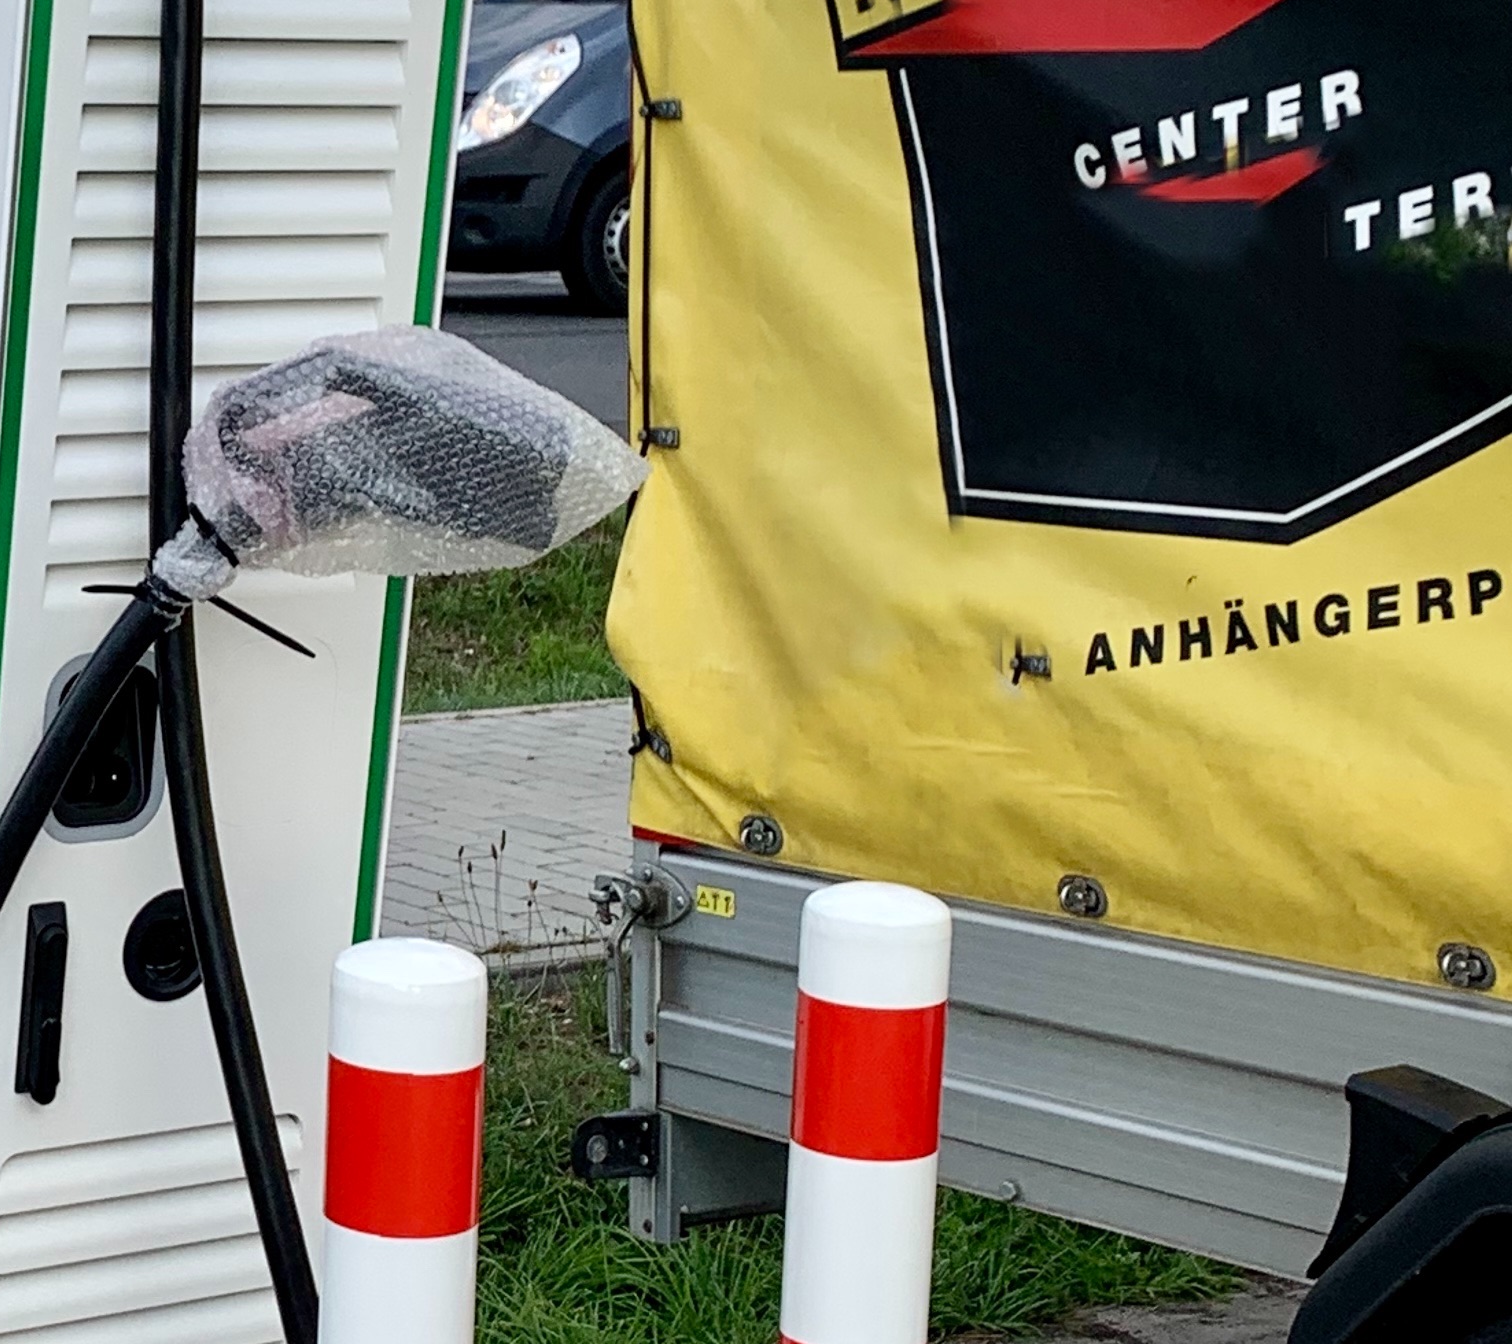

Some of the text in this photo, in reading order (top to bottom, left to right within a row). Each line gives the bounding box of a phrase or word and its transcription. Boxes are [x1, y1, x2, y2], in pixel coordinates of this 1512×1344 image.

[1073, 68, 1363, 190] CENTER
[1343, 169, 1512, 253] TER
[1084, 568, 1504, 676] ANHÄNGERP
